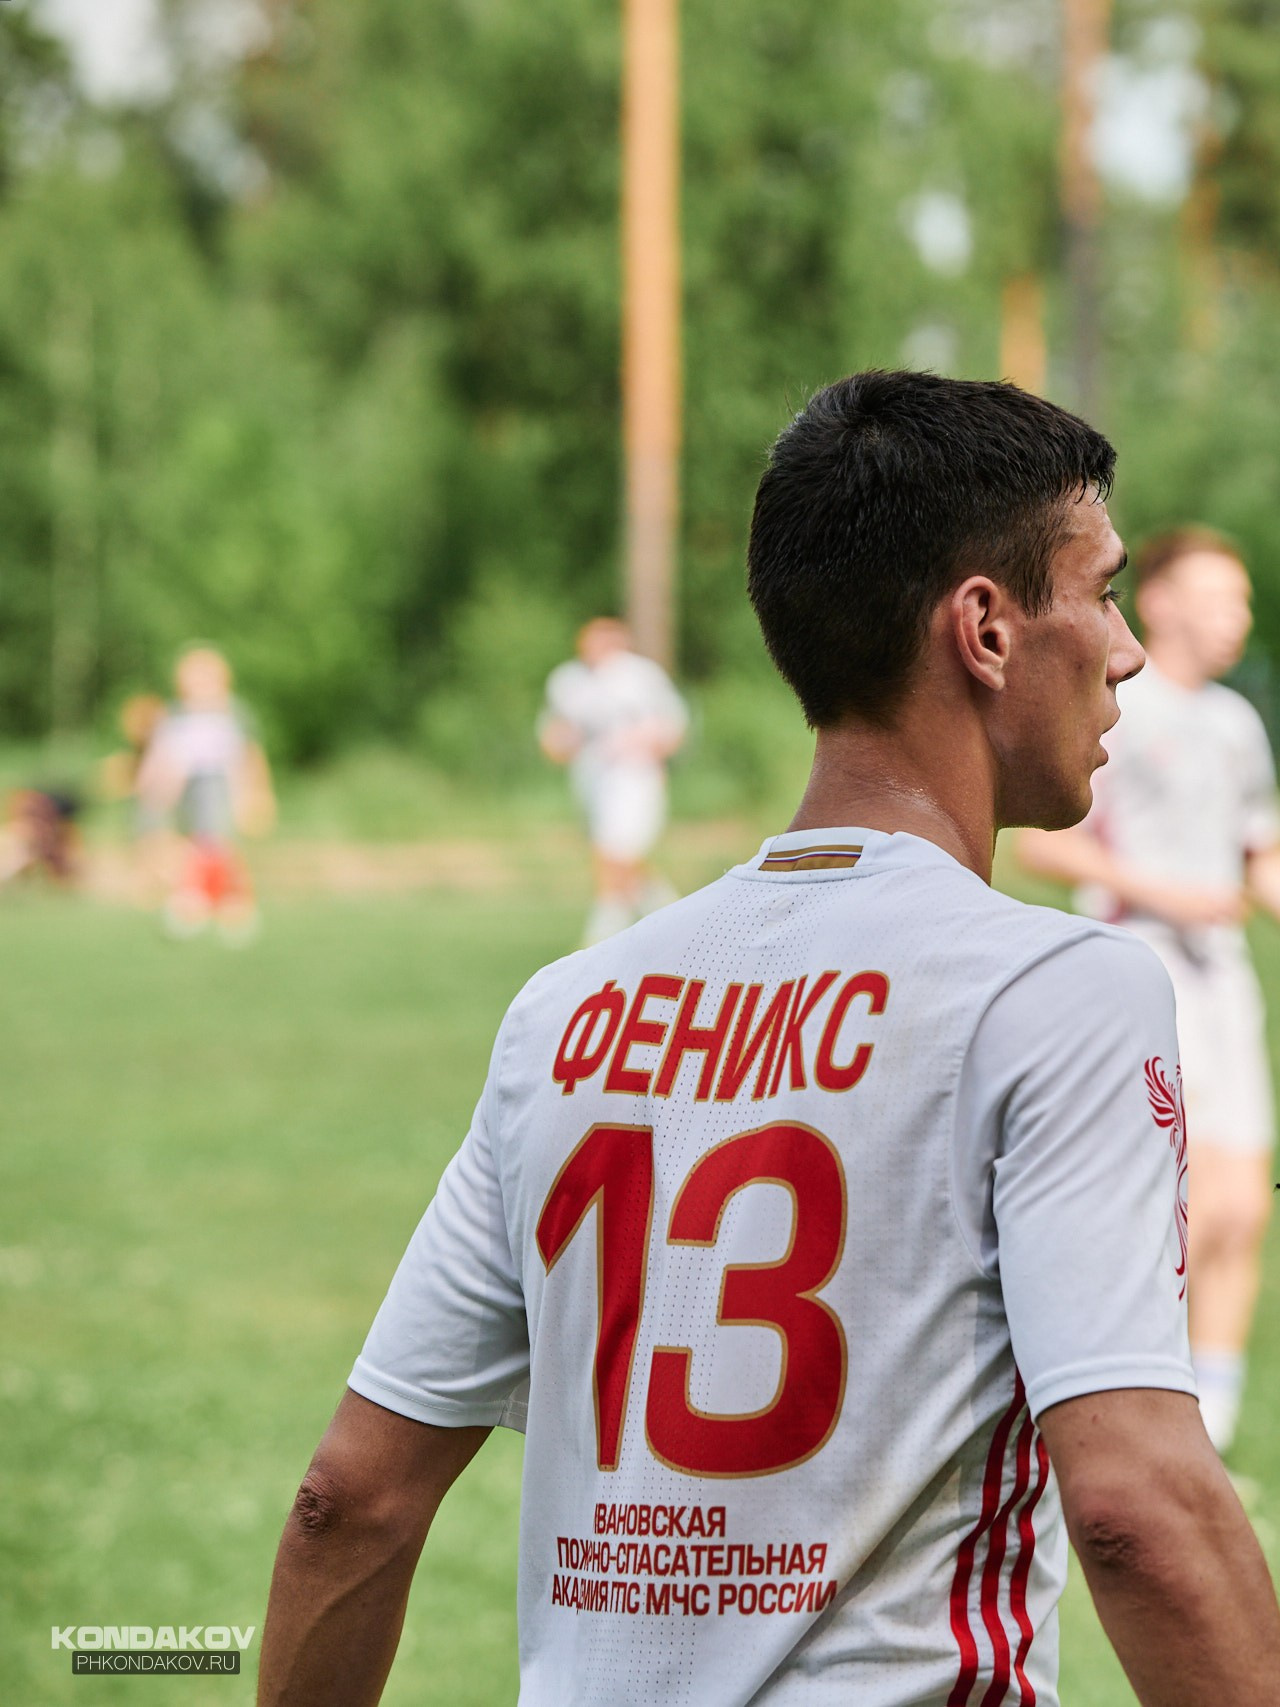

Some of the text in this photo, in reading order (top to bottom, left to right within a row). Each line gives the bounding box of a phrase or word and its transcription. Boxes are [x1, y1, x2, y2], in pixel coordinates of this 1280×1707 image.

[552, 970, 890, 1102] ФЕНИКС
[535, 1120, 848, 1479] 13
[645, 1583, 709, 1615] МЧС
[718, 1580, 838, 1615] РОССИИ
